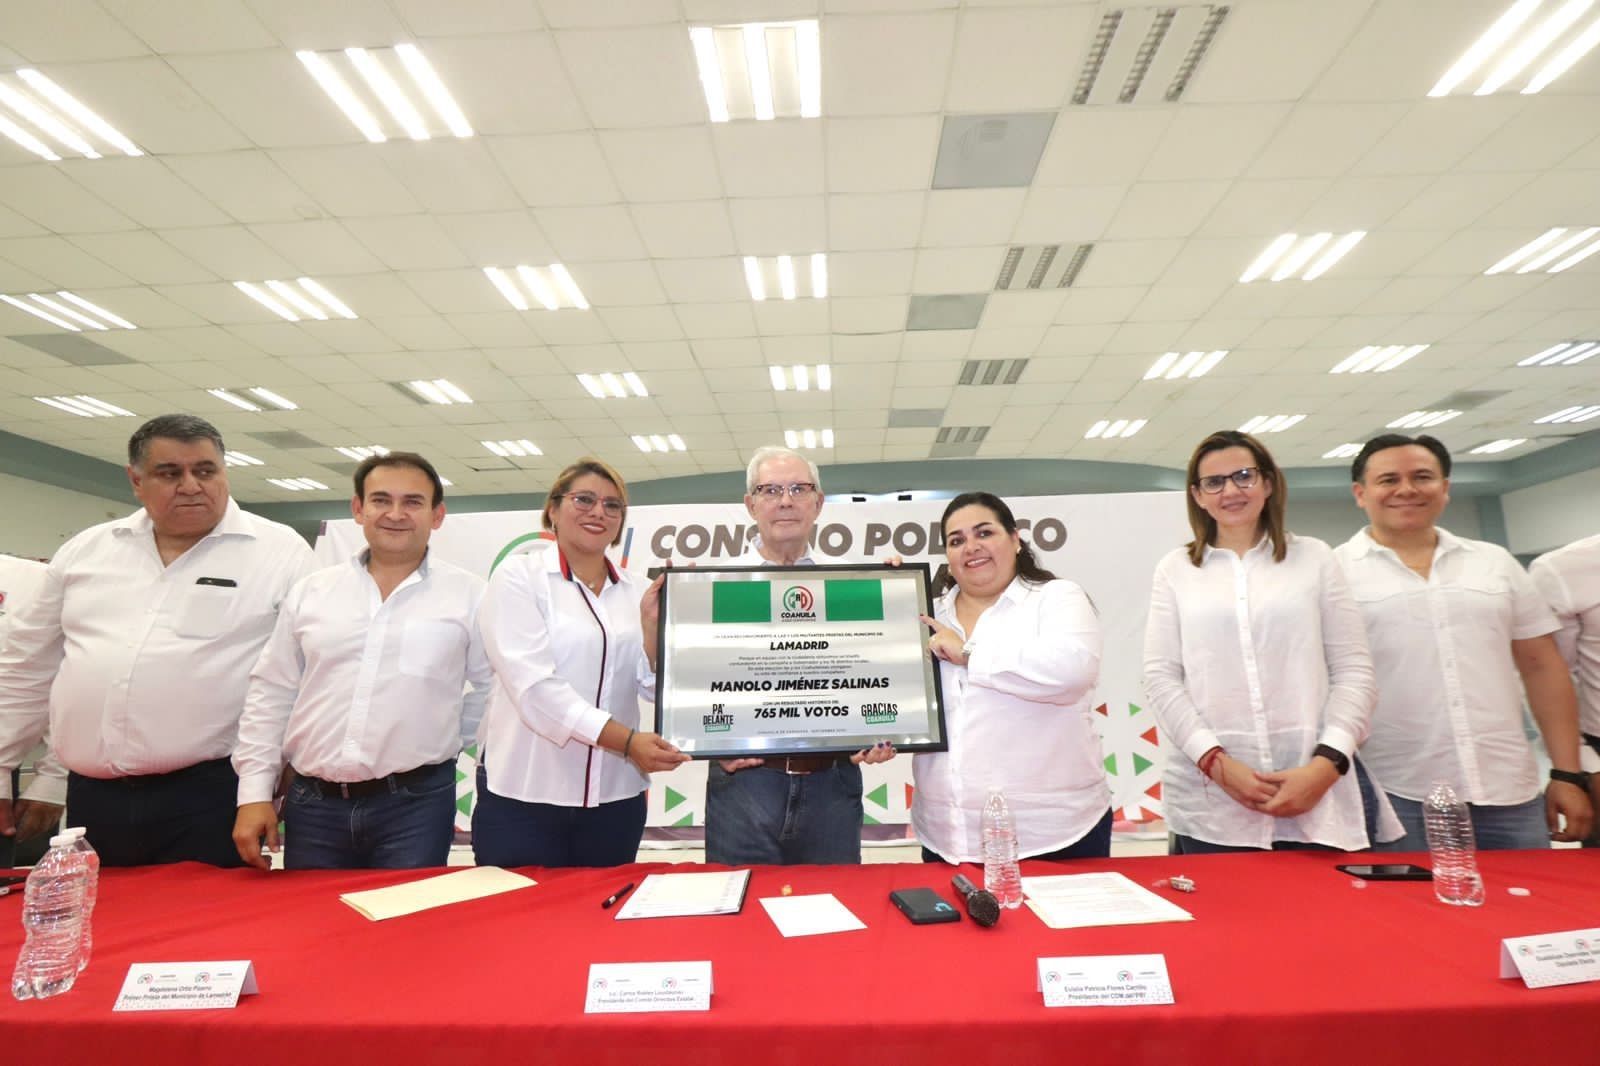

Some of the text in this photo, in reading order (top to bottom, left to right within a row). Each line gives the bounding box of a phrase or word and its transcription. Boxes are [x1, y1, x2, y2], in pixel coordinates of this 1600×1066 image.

[770, 640, 829, 651] LAMADRID
[711, 677, 889, 692] MANOLO JIMÉNEZ SALINAS
[712, 703, 725, 714] PA'
[754, 705, 849, 719] 765 MIL VOTOS
[861, 702, 898, 717] GRACIAS
[703, 714, 734, 725] DELANTE
